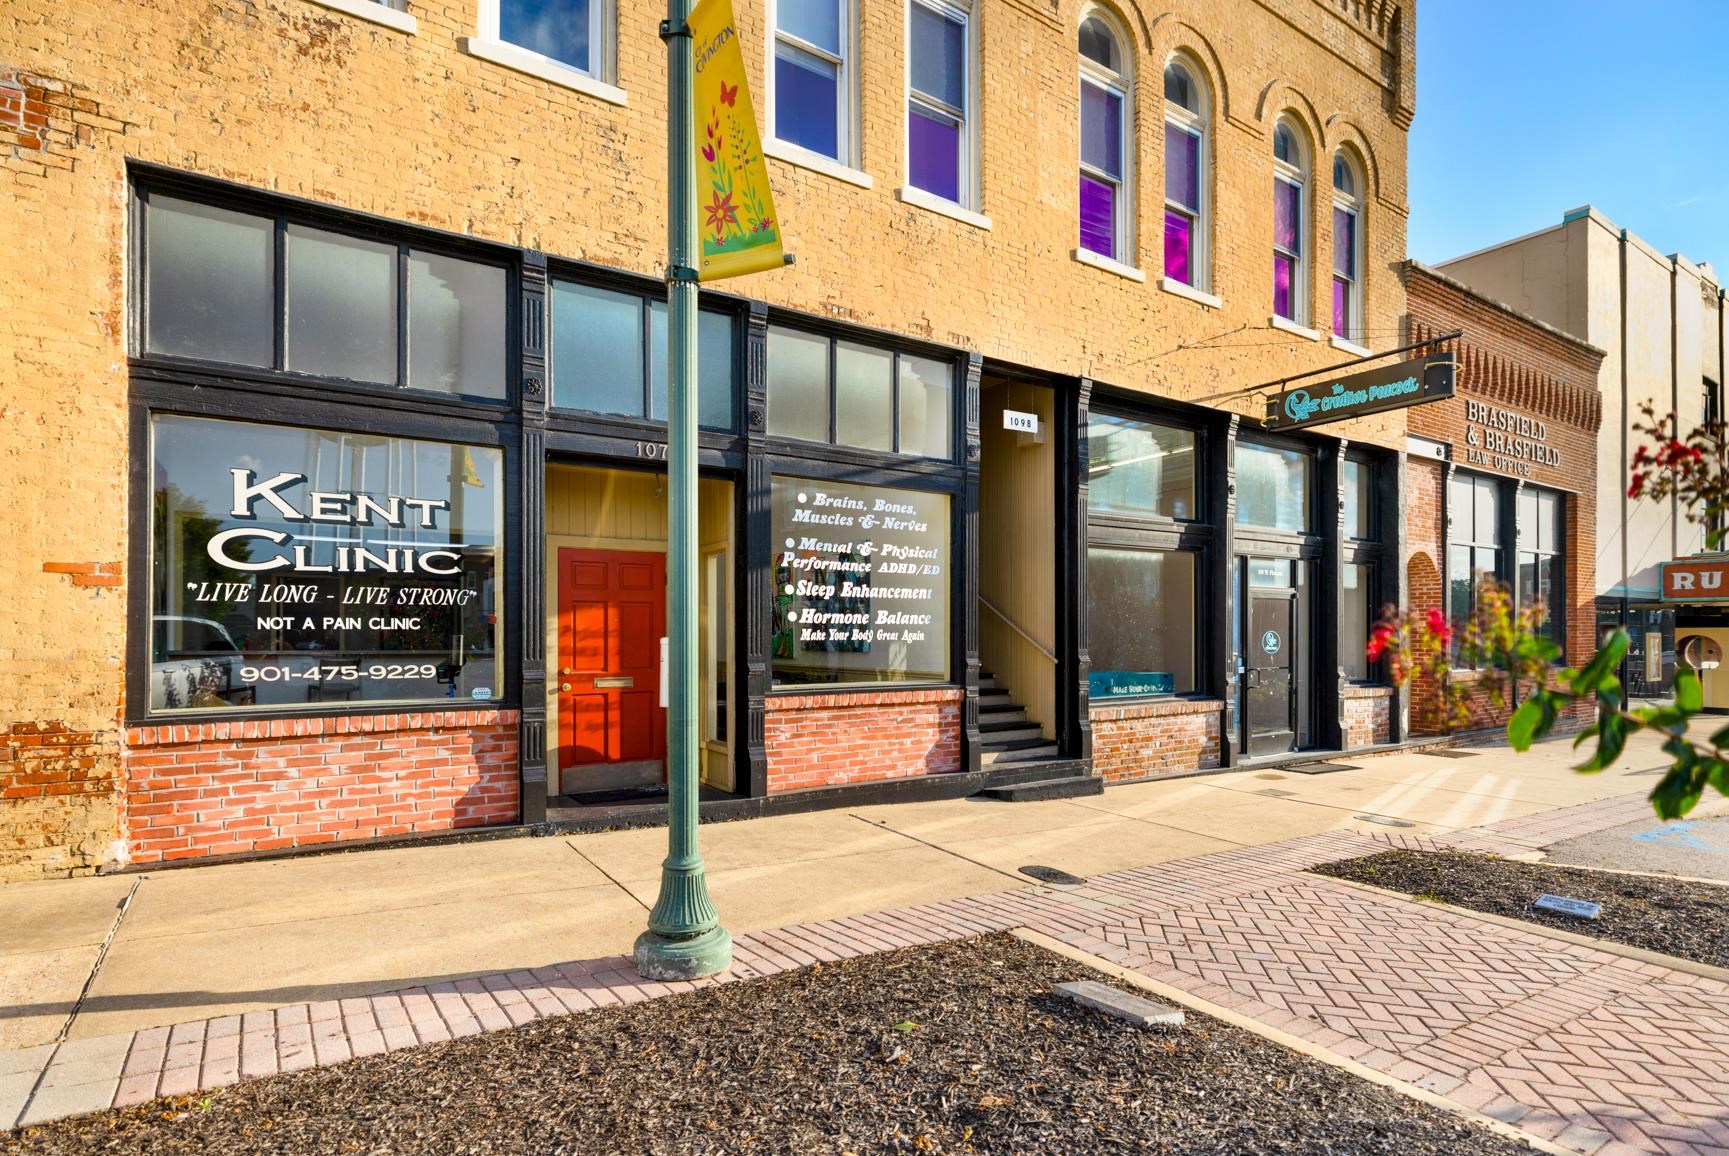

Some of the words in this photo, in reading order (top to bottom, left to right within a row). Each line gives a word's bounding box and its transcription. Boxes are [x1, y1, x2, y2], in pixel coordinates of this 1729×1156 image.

[1467, 400, 1547, 441] BRASFIELD
[635, 441, 668, 460] 107
[1468, 424, 1479, 445] &
[1485, 429, 1560, 467] BRASFIELD
[1468, 448, 1489, 465] LAW
[1495, 455, 1531, 476] OFFICE
[230, 467, 449, 528] KENT
[813, 493, 867, 511] Brains,
[873, 499, 917, 515] Bones,
[792, 509, 854, 526] Muscles
[858, 514, 880, 529] &
[882, 517, 928, 532] Nerves
[207, 527, 463, 575] CLINIC
[798, 537, 851, 553] Mental
[856, 542, 878, 556] &
[880, 543, 938, 559] Physical
[781, 552, 871, 572] Performance
[878, 562, 940, 577] ADHD/ED
[258, 584, 318, 603] LONG
[342, 586, 390, 604] LIVE
[796, 580, 835, 600] Sleep
[840, 581, 932, 599] Enhancement
[257, 617, 295, 630] NOT
[302, 617, 316, 630] A
[323, 617, 361, 630] PAIN
[369, 617, 421, 630] CLINIC
[799, 608, 869, 625] Hormone
[875, 610, 932, 625] Balance
[800, 628, 826, 641] Make
[828, 628, 849, 641] Your
[851, 629, 873, 643] Body
[877, 629, 899, 641] Great
[901, 629, 925, 644] Again
[240, 664, 437, 682] 901-475-9229
